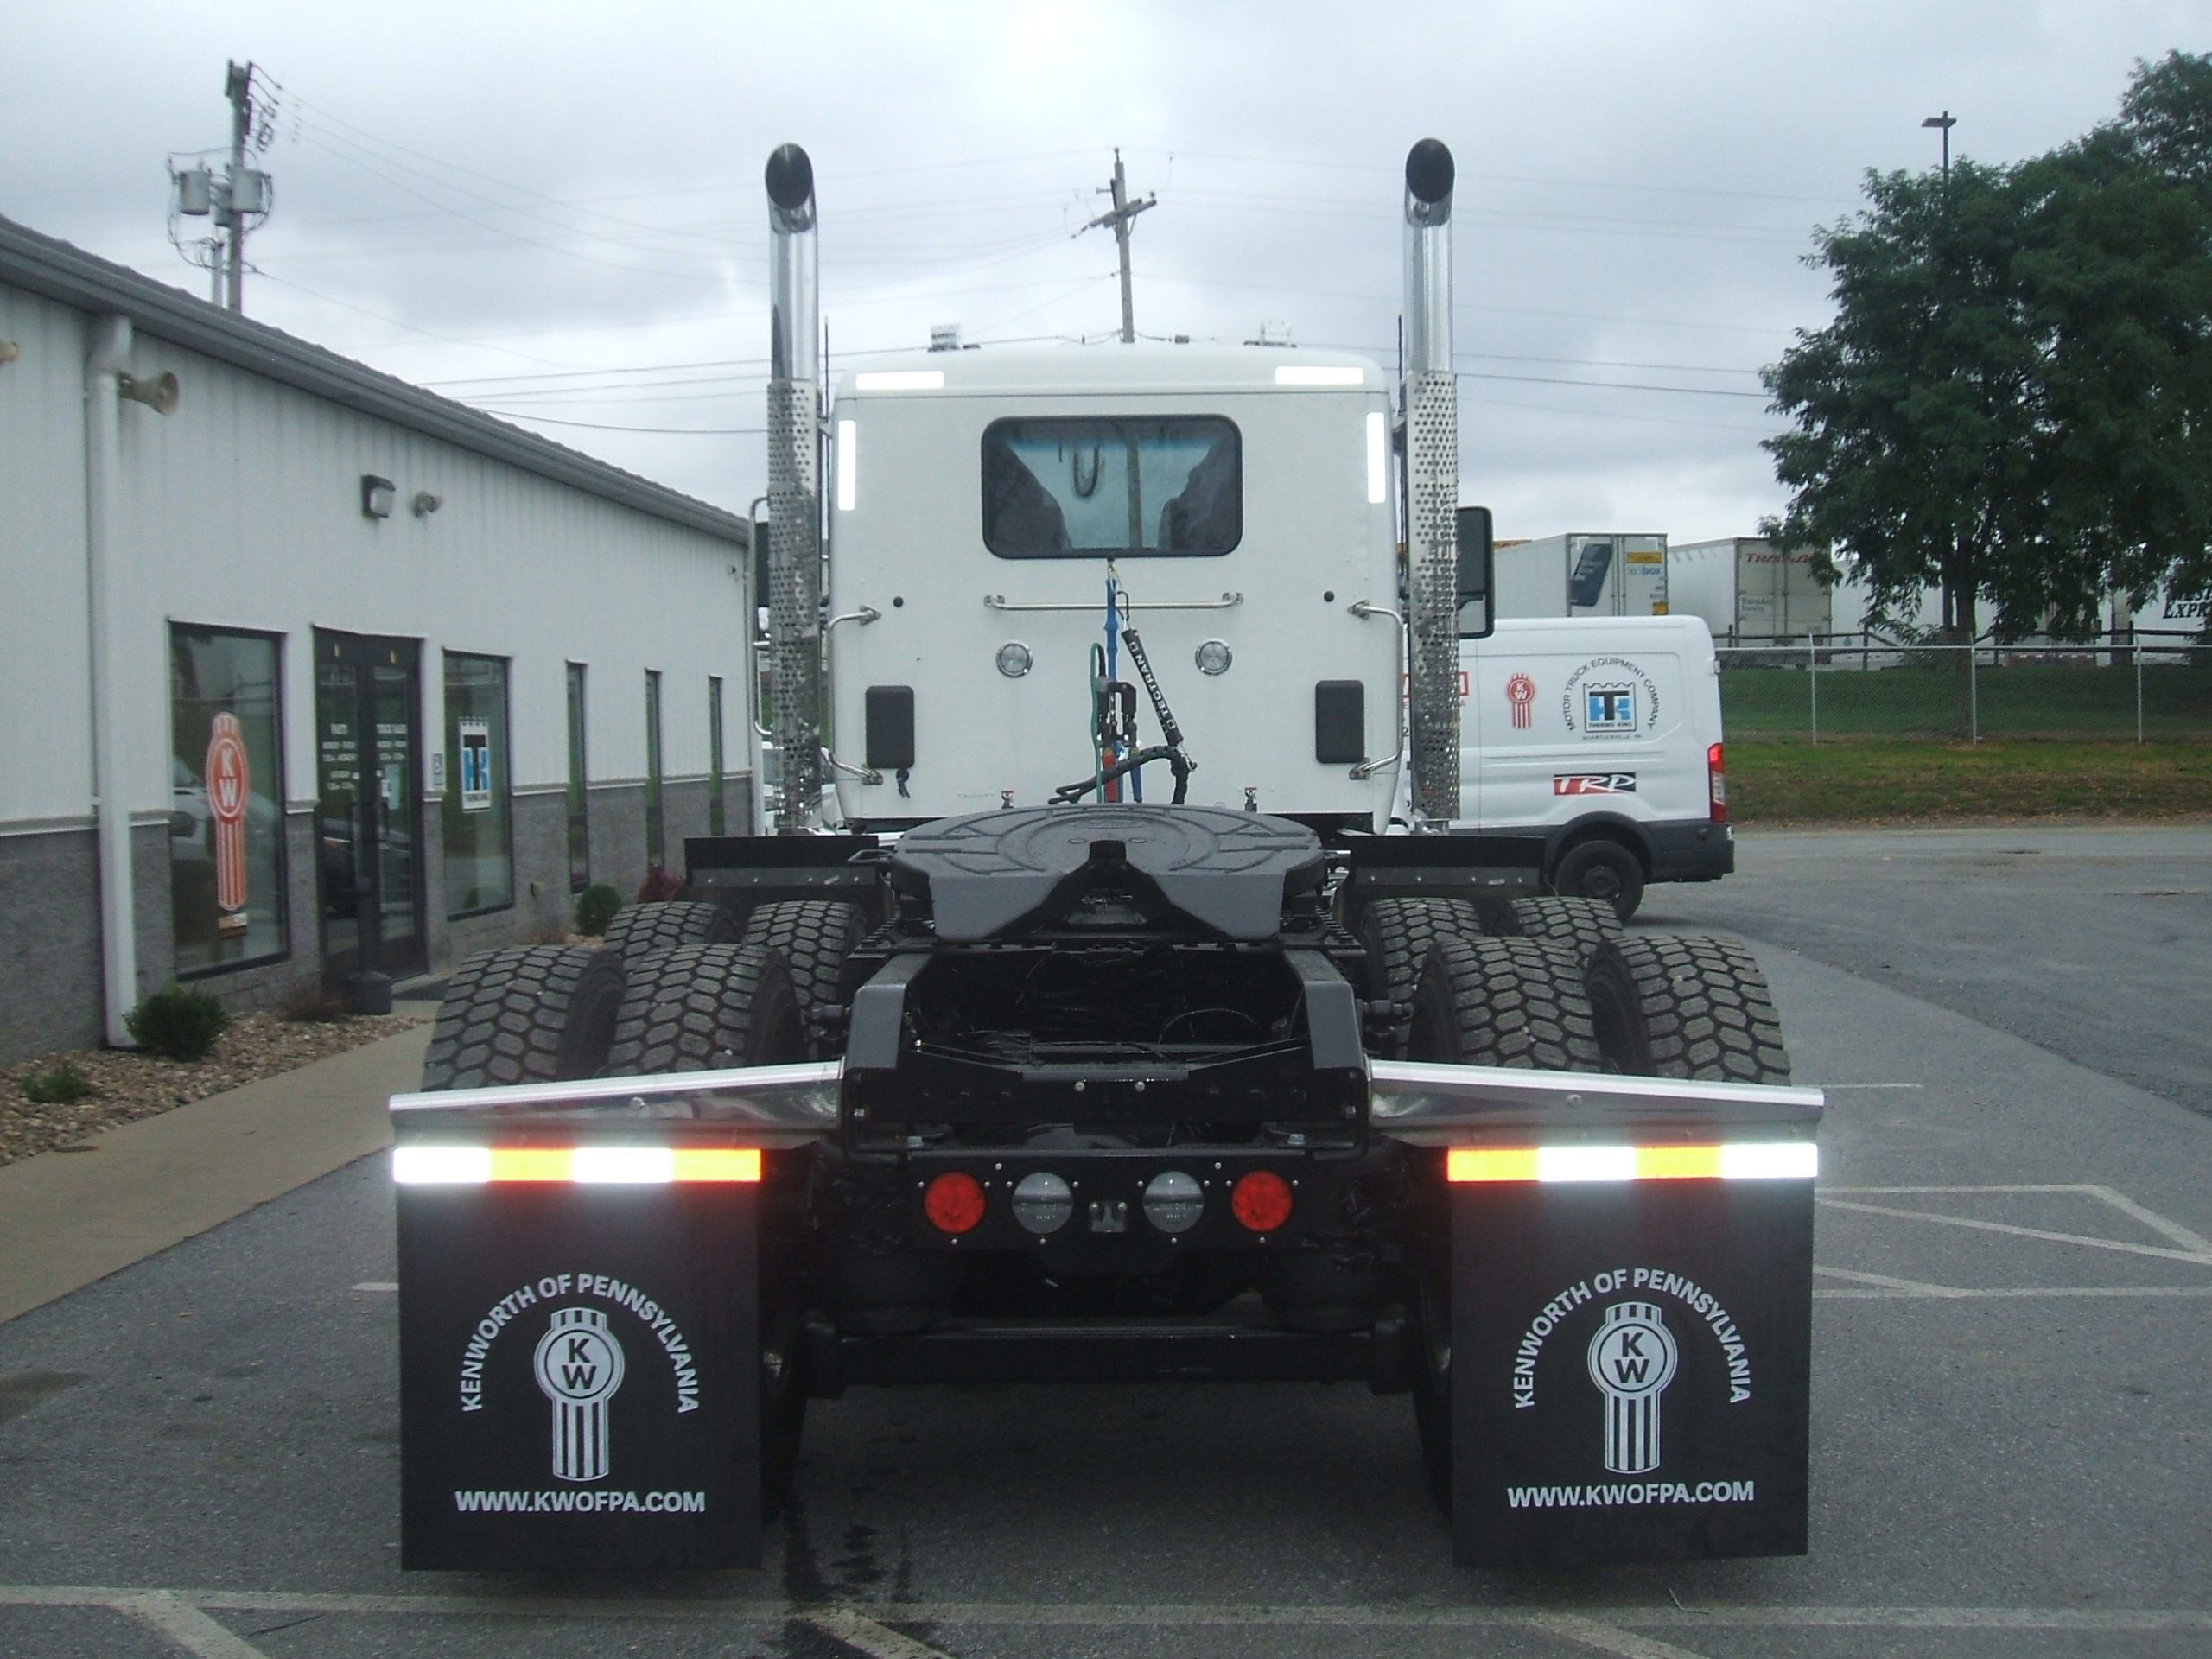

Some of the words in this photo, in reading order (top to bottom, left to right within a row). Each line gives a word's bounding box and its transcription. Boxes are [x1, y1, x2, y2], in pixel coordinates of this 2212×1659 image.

[1565, 664, 1590, 691] TRUCK
[1591, 658, 1644, 677] EQUIPMENT
[1135, 654, 1169, 717] TECTRAN
[1563, 694, 1575, 731] MOTOR
[1643, 679, 1659, 729] COMPANY
[1554, 773, 1635, 794] TRP
[461, 1285, 537, 1412] KENWORTH
[537, 1274, 571, 1297] OF
[578, 1274, 700, 1414] PENNSYLVANIA
[1513, 1281, 1592, 1409] KENWORTH
[1593, 1268, 1627, 1294] OF
[1634, 1268, 1751, 1403] PENNSYLVANIA
[454, 1491, 706, 1513] WWW.KWOFPA.COM
[1507, 1480, 1755, 1508] WWW.KWOFPA.COM
